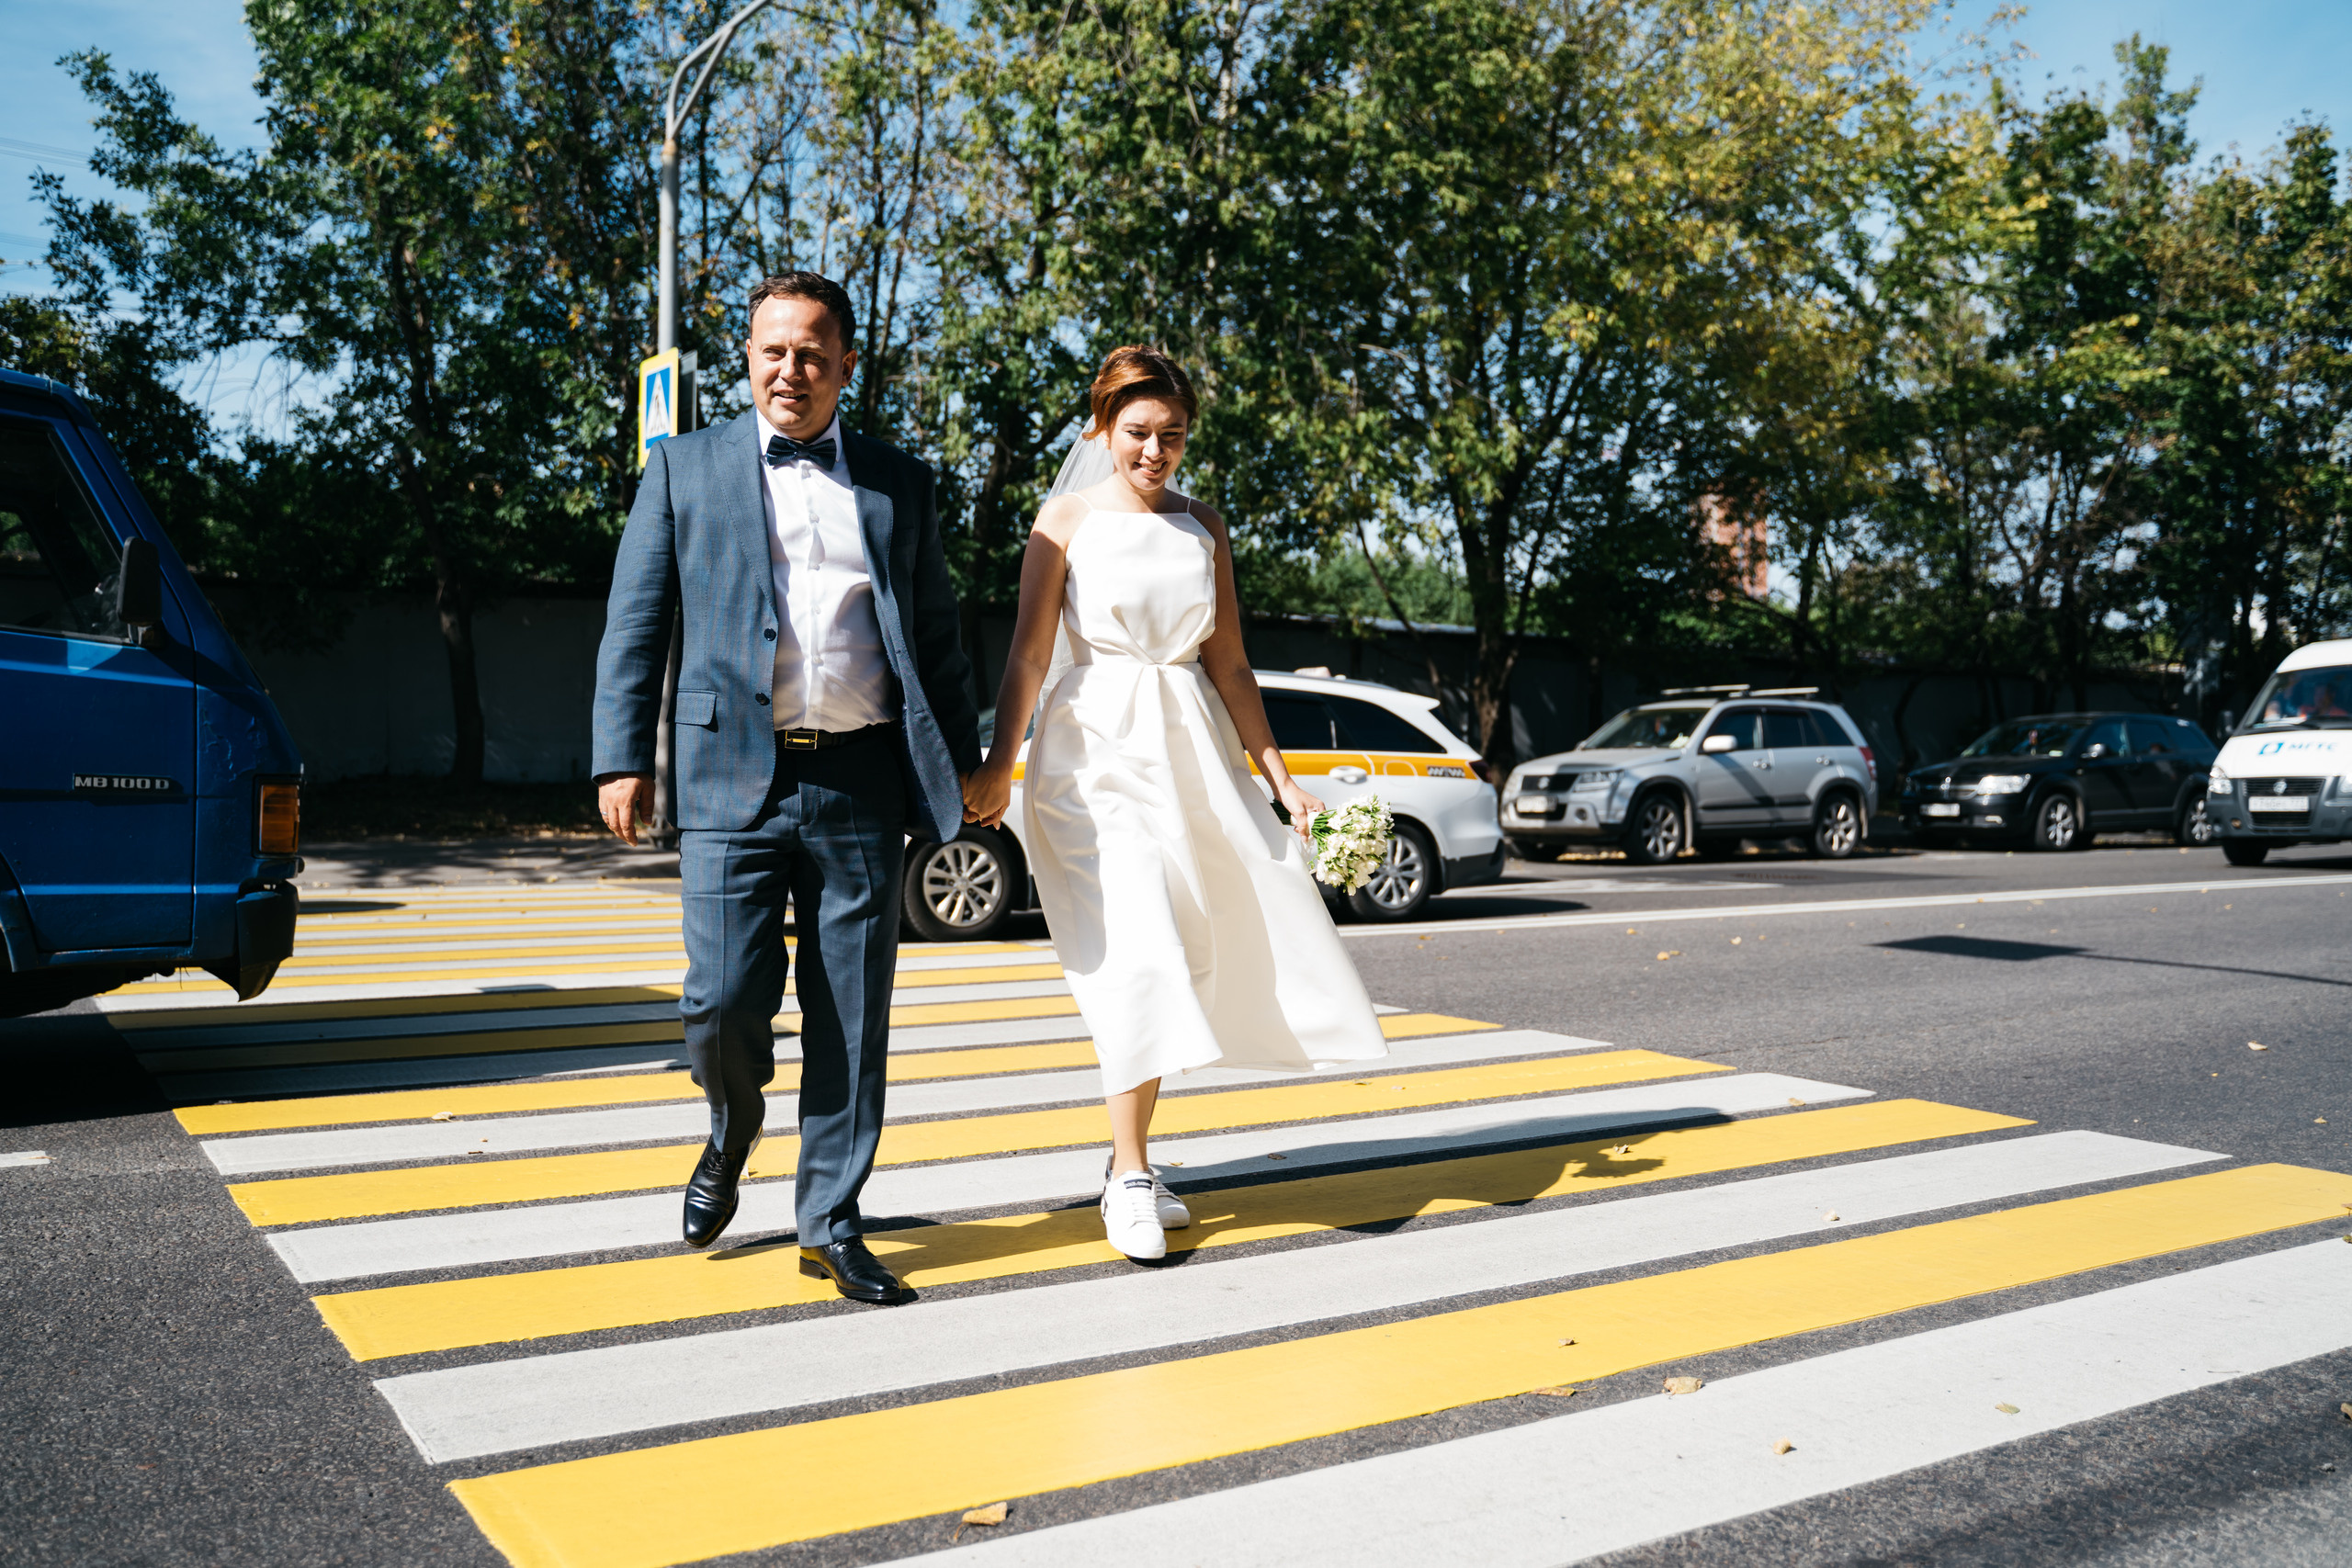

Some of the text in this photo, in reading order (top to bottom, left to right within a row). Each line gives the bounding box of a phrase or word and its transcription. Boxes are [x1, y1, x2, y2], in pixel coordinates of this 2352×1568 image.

[74, 776, 169, 790] MB 100 D
